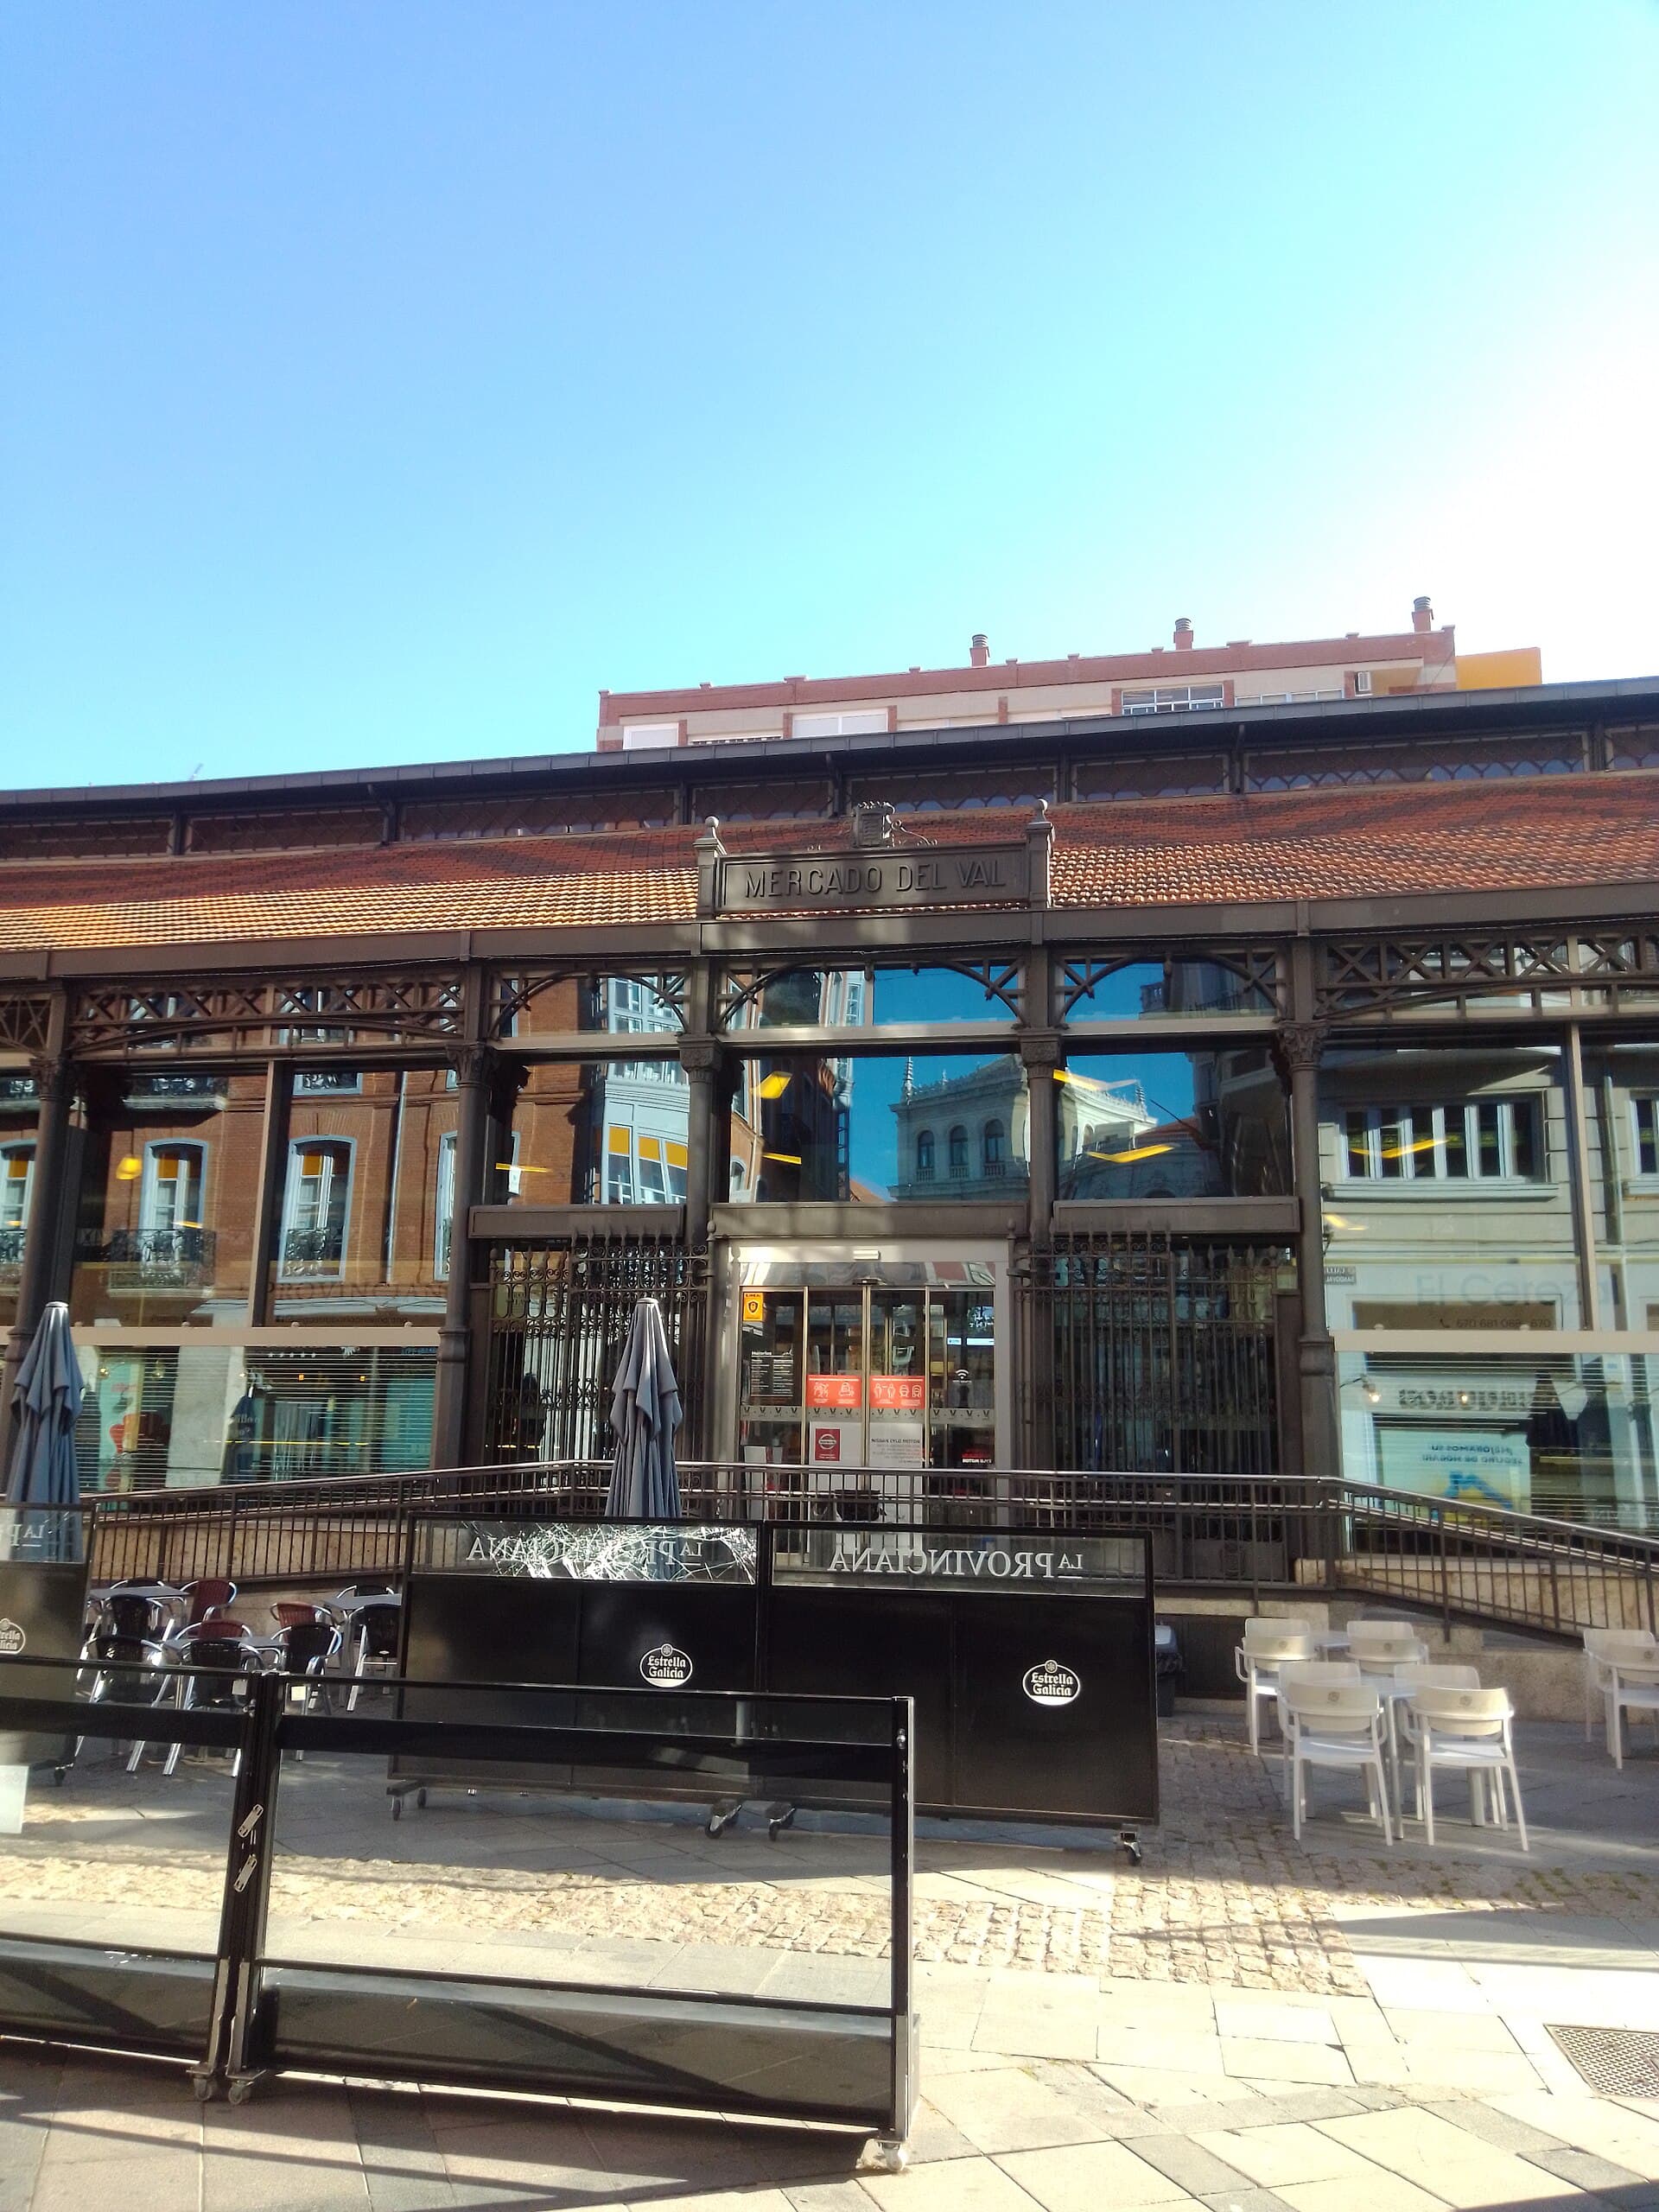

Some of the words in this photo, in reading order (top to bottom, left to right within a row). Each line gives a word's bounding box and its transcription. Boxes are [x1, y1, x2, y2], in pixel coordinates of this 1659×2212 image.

[745, 865, 882, 899] MERCADO
[896, 862, 946, 892] DEL
[957, 860, 1006, 887] VAL
[1415, 1274, 1446, 1306] El
[647, 1655, 687, 1668] Estrella
[648, 1666, 684, 1680] Galicia
[1031, 1672, 1074, 1685] Estrella
[1033, 1682, 1072, 1697] Galicia
